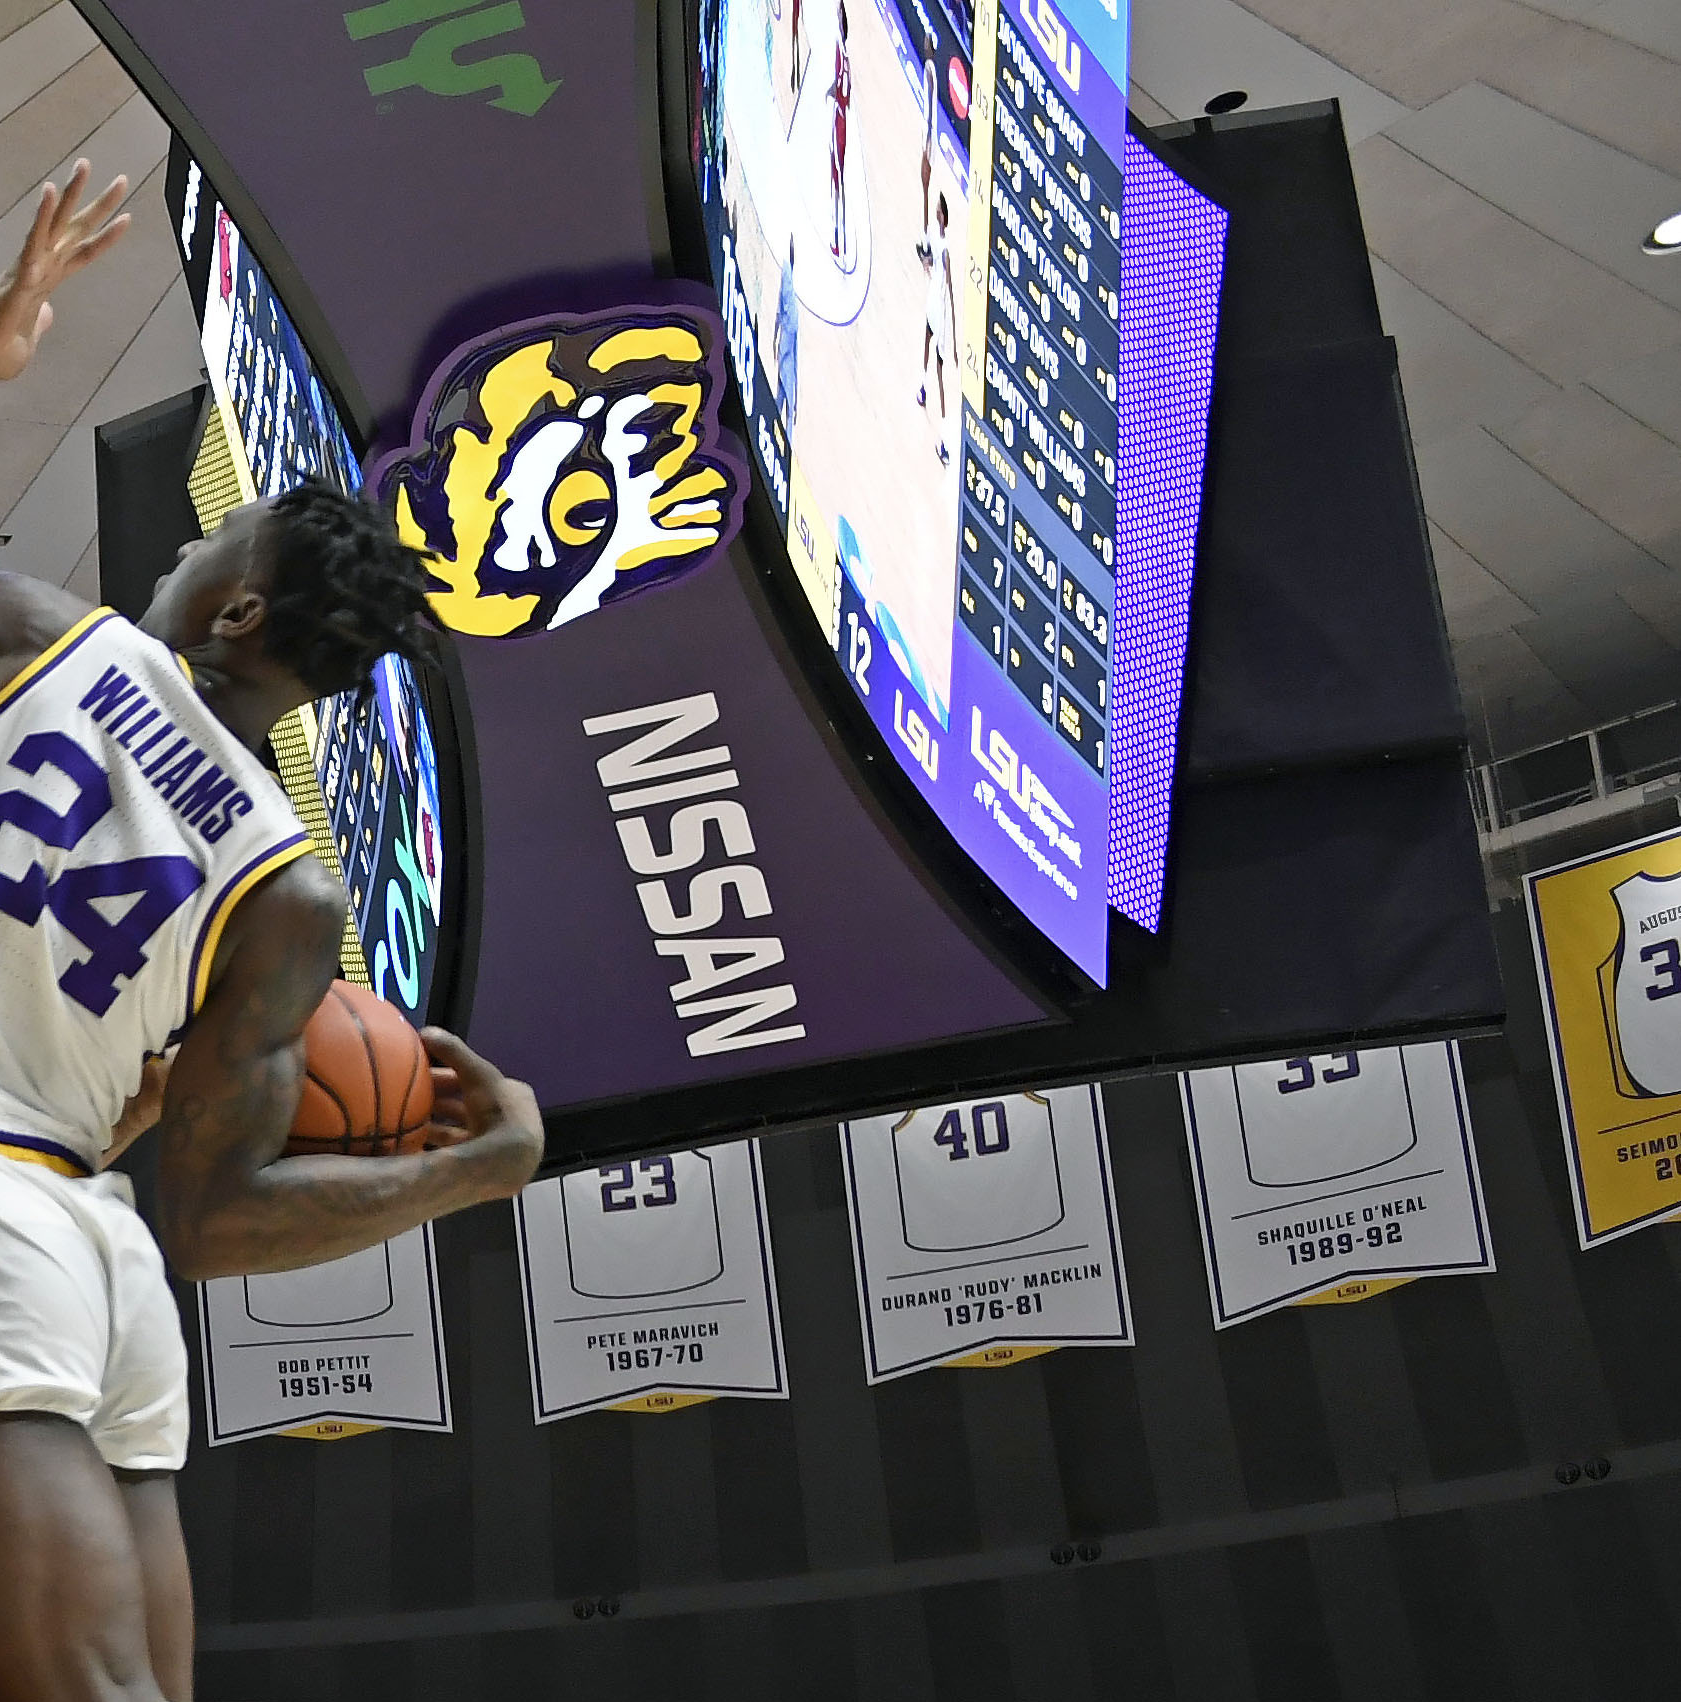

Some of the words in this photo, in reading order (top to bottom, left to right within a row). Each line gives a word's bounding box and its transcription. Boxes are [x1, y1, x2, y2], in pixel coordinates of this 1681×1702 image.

[1046, 89, 1086, 157] SMART
[995, 95, 1045, 187] TREMONT
[1045, 171, 1091, 249] WATERS
[1038, 247, 1081, 321] TAYLOR
[989, 266, 1029, 341] DARIUS
[1030, 324, 1059, 380] DAYS
[1029, 410, 1086, 497] WILLIAMS
[976, 471, 1005, 527] 37.5
[1026, 537, 1057, 590] 20.0
[1075, 593, 1107, 645] 83.3
[847, 612, 872, 696] 12
[78, 664, 254, 845] WILLIAMS
[894, 688, 939, 782] LSU
[970, 705, 1032, 813] LSU
[582, 692, 806, 1058] NISSAN
[933, 1100, 1011, 1161] 40
[598, 1154, 679, 1214] 23
[1258, 1208, 1357, 1247] SHAQUILLE
[1361, 1196, 1427, 1224] O'NEAL
[1285, 1222, 1403, 1267] 1989-92
[882, 1285, 951, 1313] DURAND
[1023, 1263, 1103, 1290] MACKLIN
[944, 1293, 1044, 1328] 1976-81
[277, 1358, 306, 1376] BOB
[314, 1354, 371, 1373] PETTIT
[587, 1333, 629, 1351] PETE
[633, 1322, 720, 1345] MARAVICH
[606, 1343, 704, 1373] 1967-70
[278, 1372, 373, 1400] 1951-54
